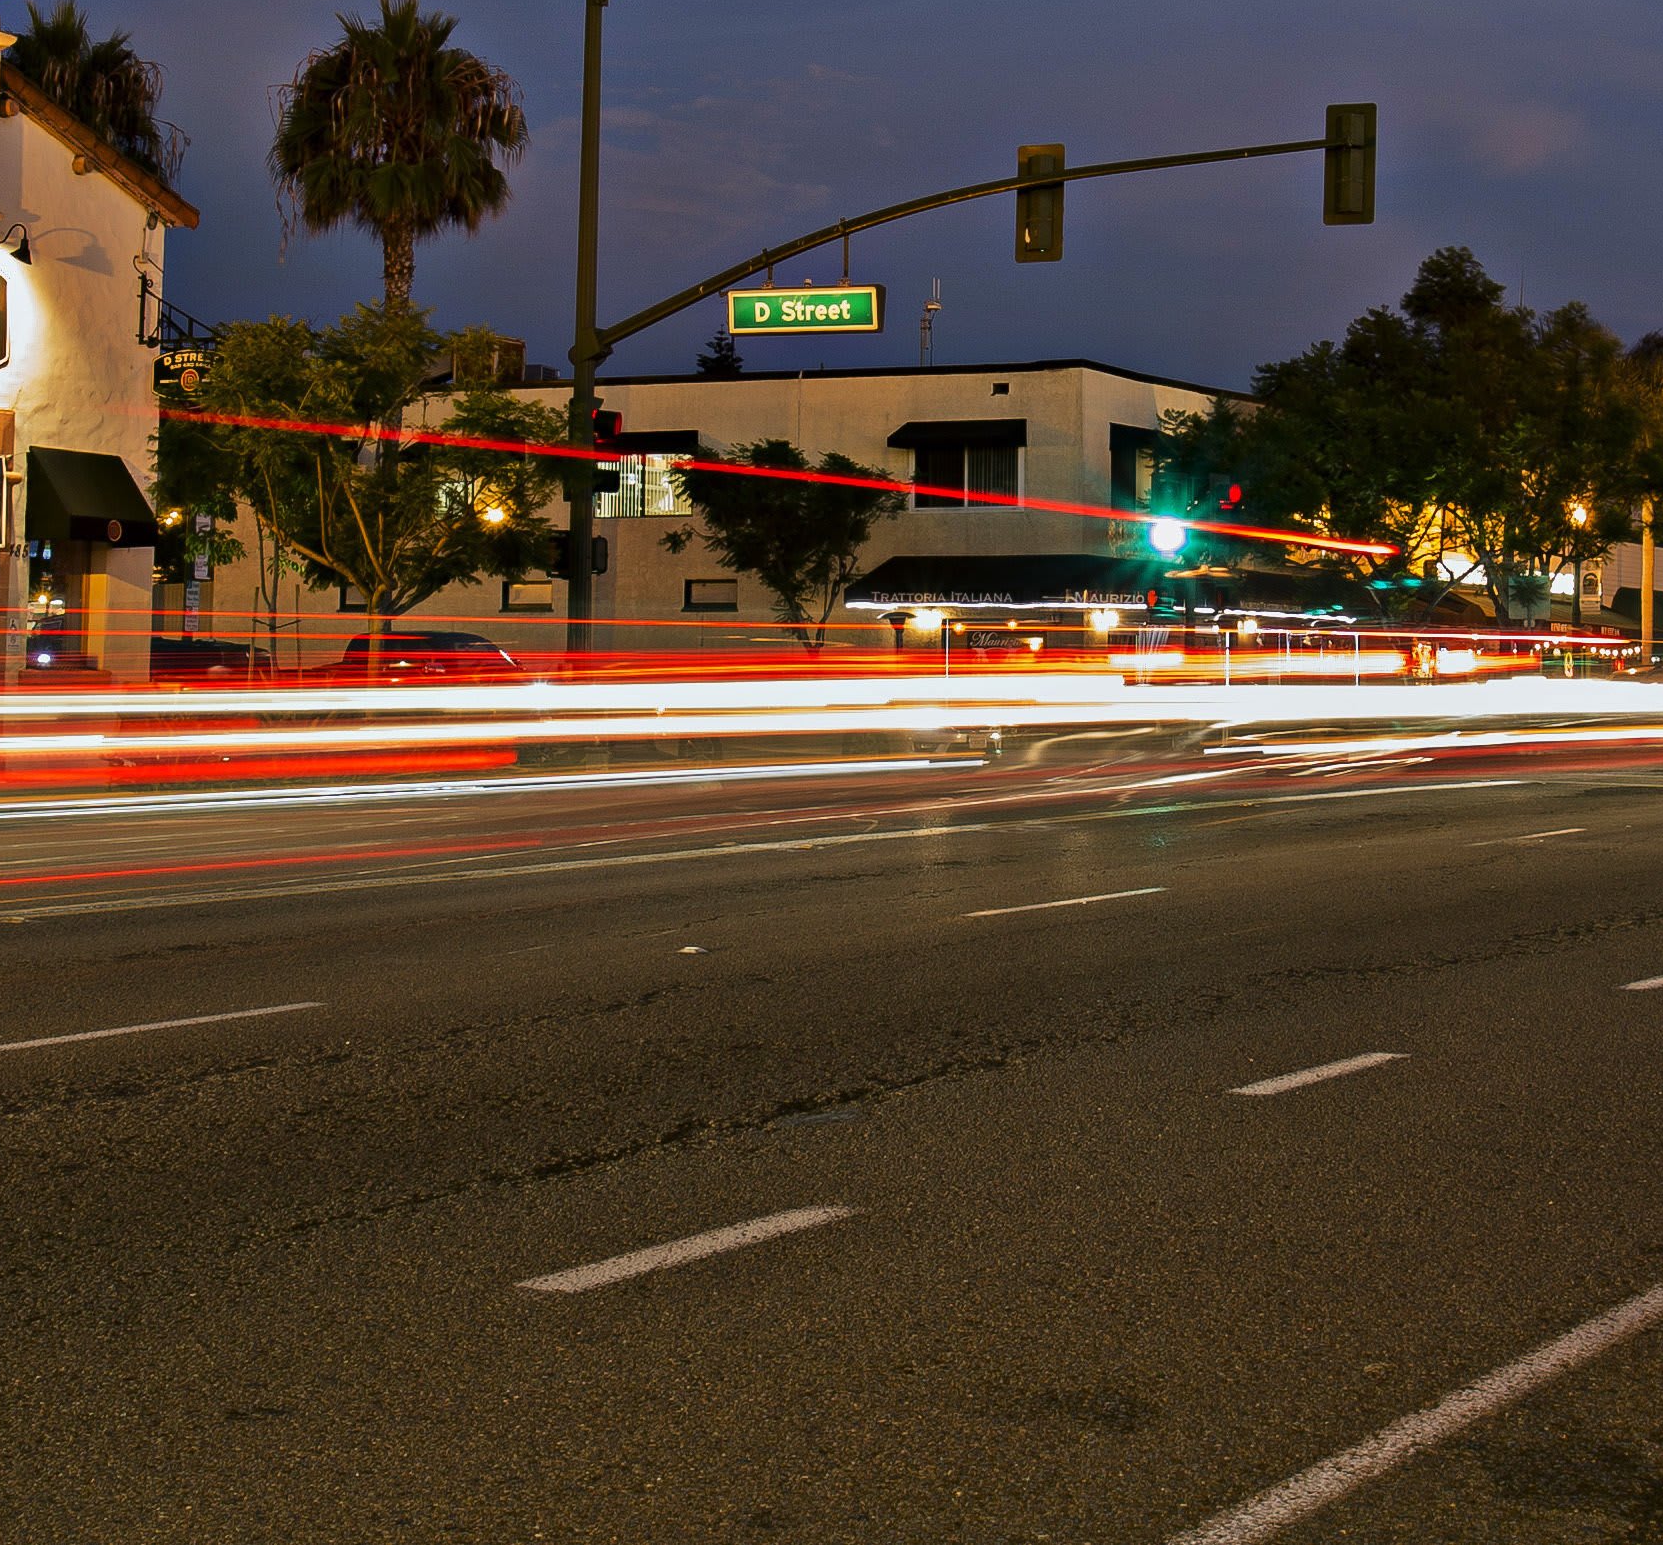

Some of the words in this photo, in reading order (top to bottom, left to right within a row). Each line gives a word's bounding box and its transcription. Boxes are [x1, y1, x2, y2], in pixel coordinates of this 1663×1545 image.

[754, 301, 771, 323] D
[781, 299, 851, 322] Street
[164, 357, 172, 366] D
[871, 591, 945, 603] TRATTORIA
[951, 591, 1013, 603] ITALIANA
[1075, 591, 1145, 604] MAURIZIO
